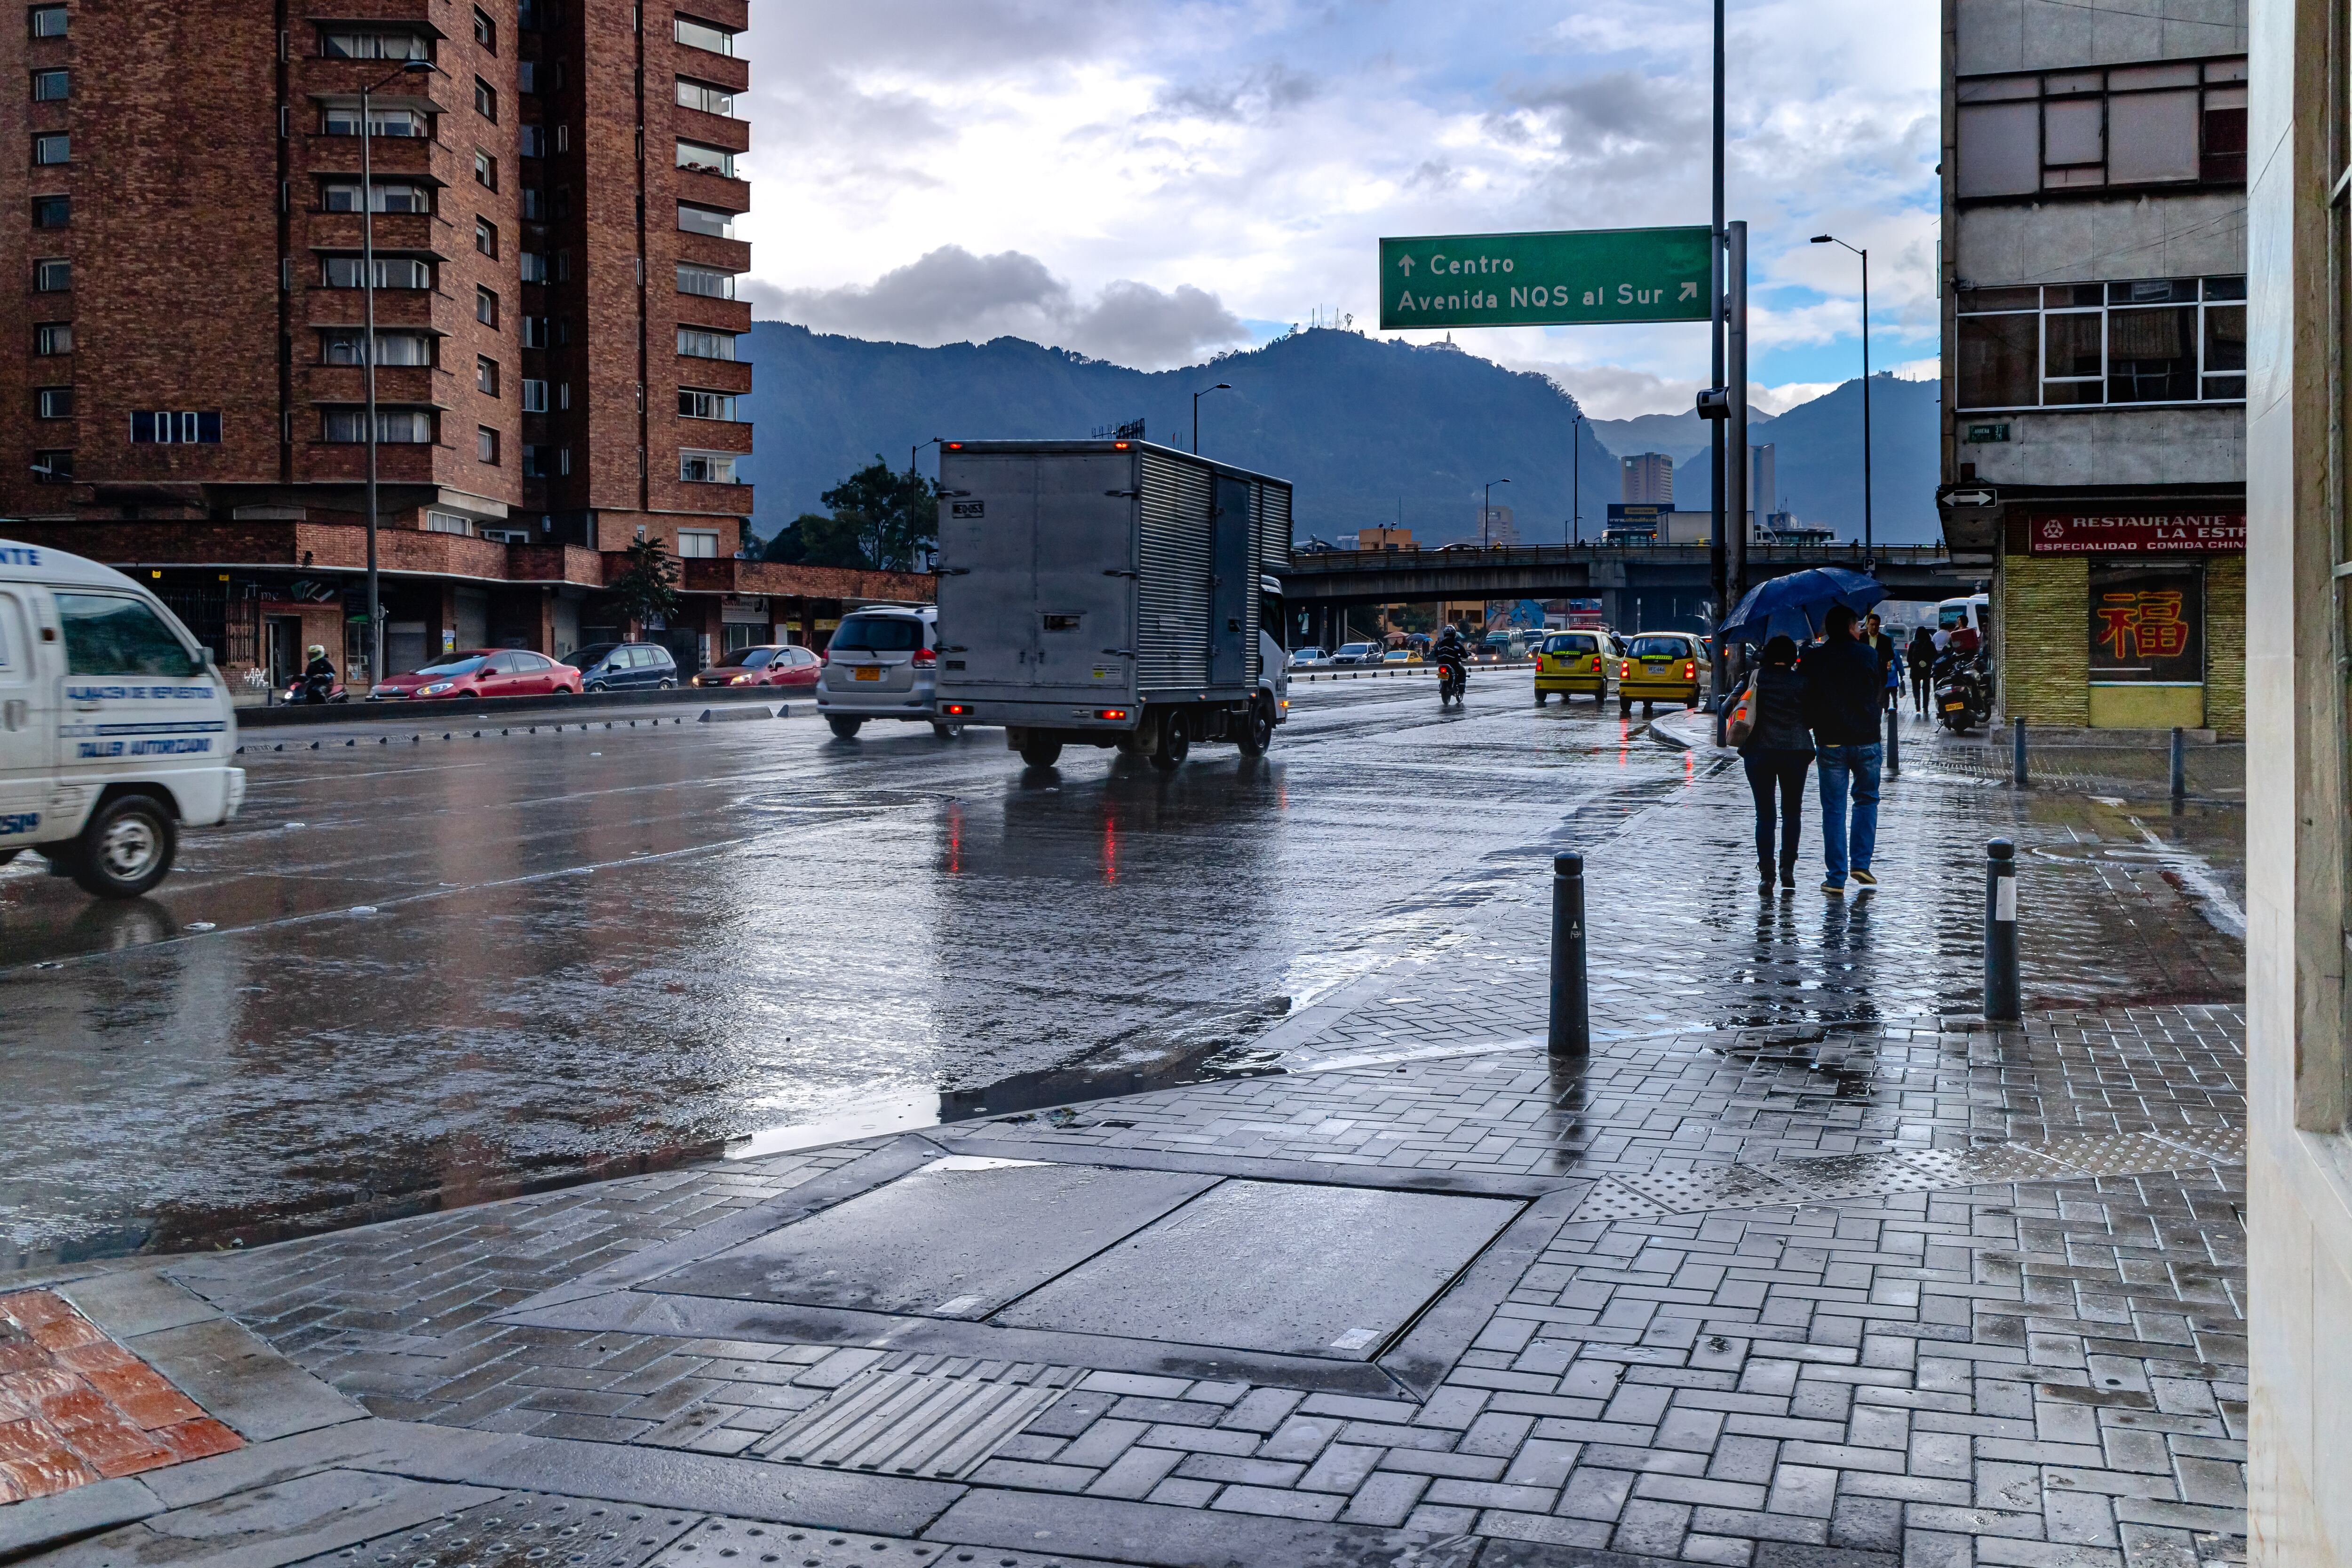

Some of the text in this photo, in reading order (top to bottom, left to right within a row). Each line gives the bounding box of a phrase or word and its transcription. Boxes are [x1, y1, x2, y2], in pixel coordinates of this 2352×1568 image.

[1430, 254, 1514, 275] Centro
[1398, 284, 1663, 311] Avenida NQS al Sur
[2073, 516, 2226, 527] RESTAURANTE
[2157, 528, 2187, 538] LA
[1865, 559, 1875, 569] P
[2097, 591, 2188, 658] 福
